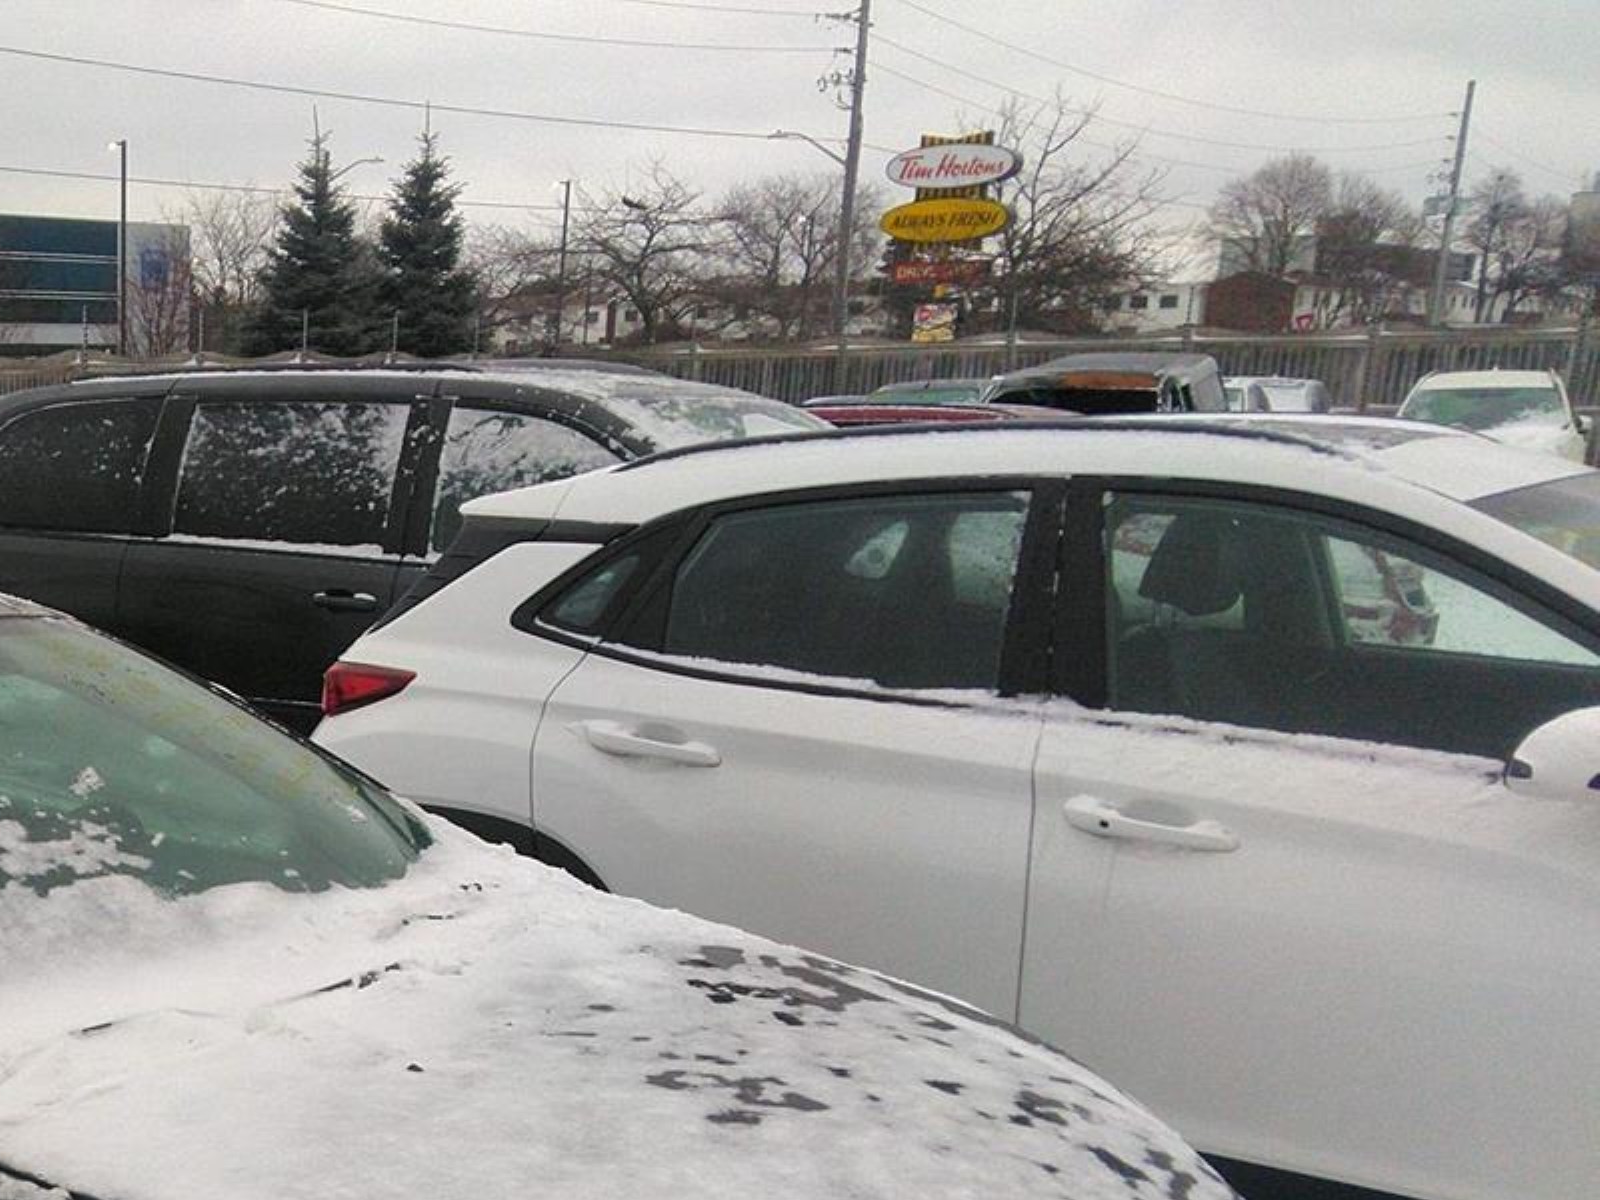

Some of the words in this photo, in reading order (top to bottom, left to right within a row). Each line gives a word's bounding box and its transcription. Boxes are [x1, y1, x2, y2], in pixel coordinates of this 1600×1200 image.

[899, 154, 933, 179] Tim
[935, 153, 1004, 178] Hortons
[889, 213, 945, 230] ALWAYS
[947, 210, 1000, 228] FRESH
